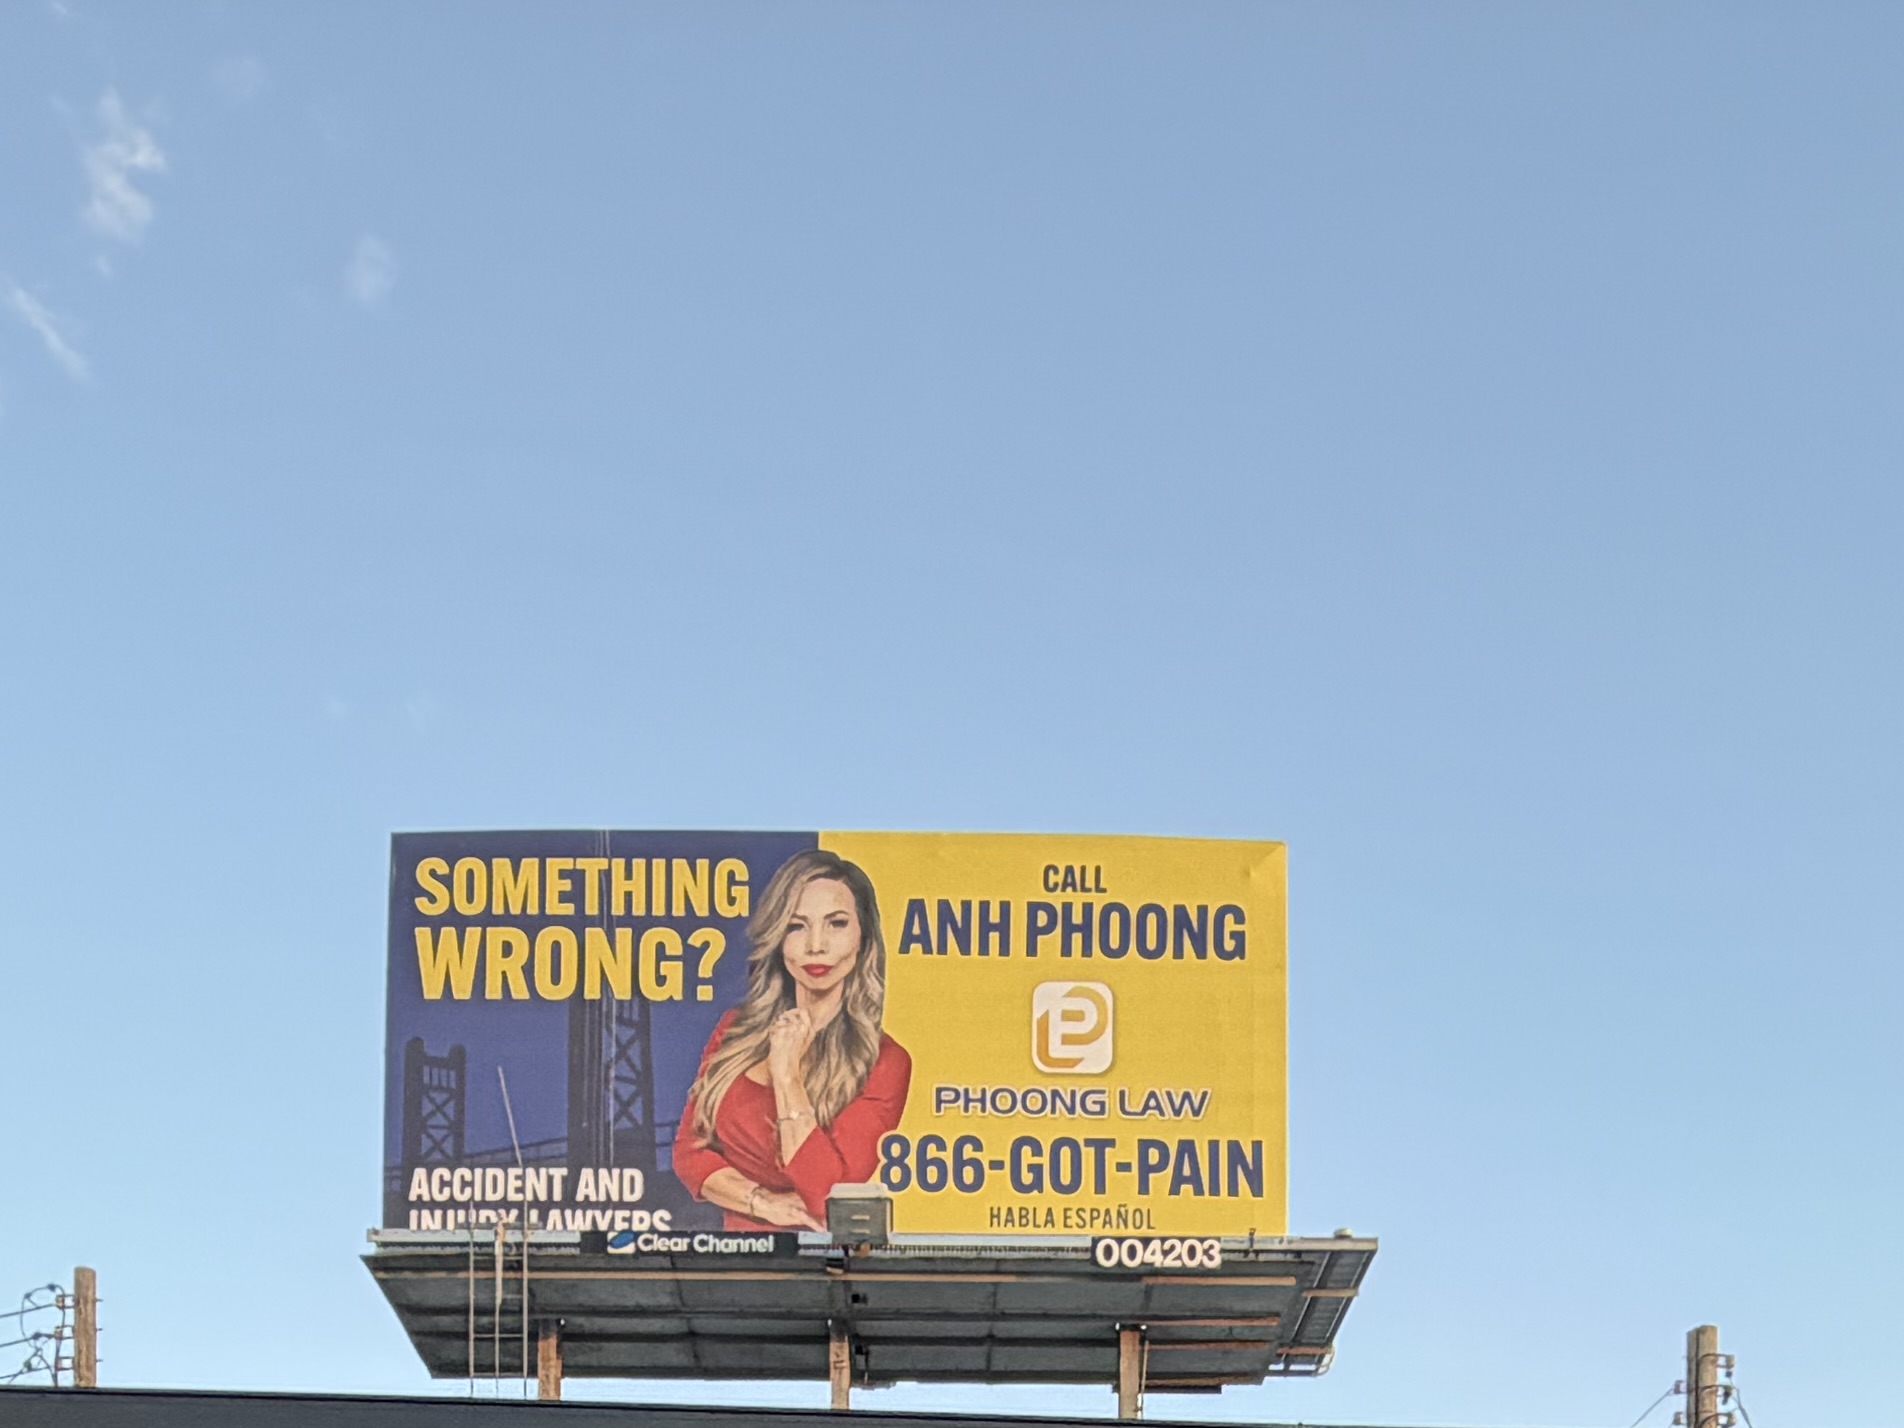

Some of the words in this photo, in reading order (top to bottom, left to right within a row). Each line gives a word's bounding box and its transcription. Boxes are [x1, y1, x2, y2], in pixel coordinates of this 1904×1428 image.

[415, 857, 749, 917] SOMETHING
[1043, 865, 1107, 893] CALL
[898, 898, 1010, 957] ANH
[1026, 901, 1246, 961] PHOONG
[415, 926, 726, 1001] WRONG?
[934, 1086, 1106, 1117] PHOONG
[1118, 1089, 1211, 1118] LAW
[880, 1134, 1264, 1198] 866-GOT-PAIN
[409, 1167, 568, 1202] ACCIDENT
[575, 1168, 644, 1202] AND
[989, 1206, 1055, 1229] HABLA
[1063, 1204, 1156, 1230] ESPAÑOL
[637, 1233, 691, 1252] Clear
[693, 1234, 774, 1253] Channel
[1096, 1238, 1221, 1268] 004203
